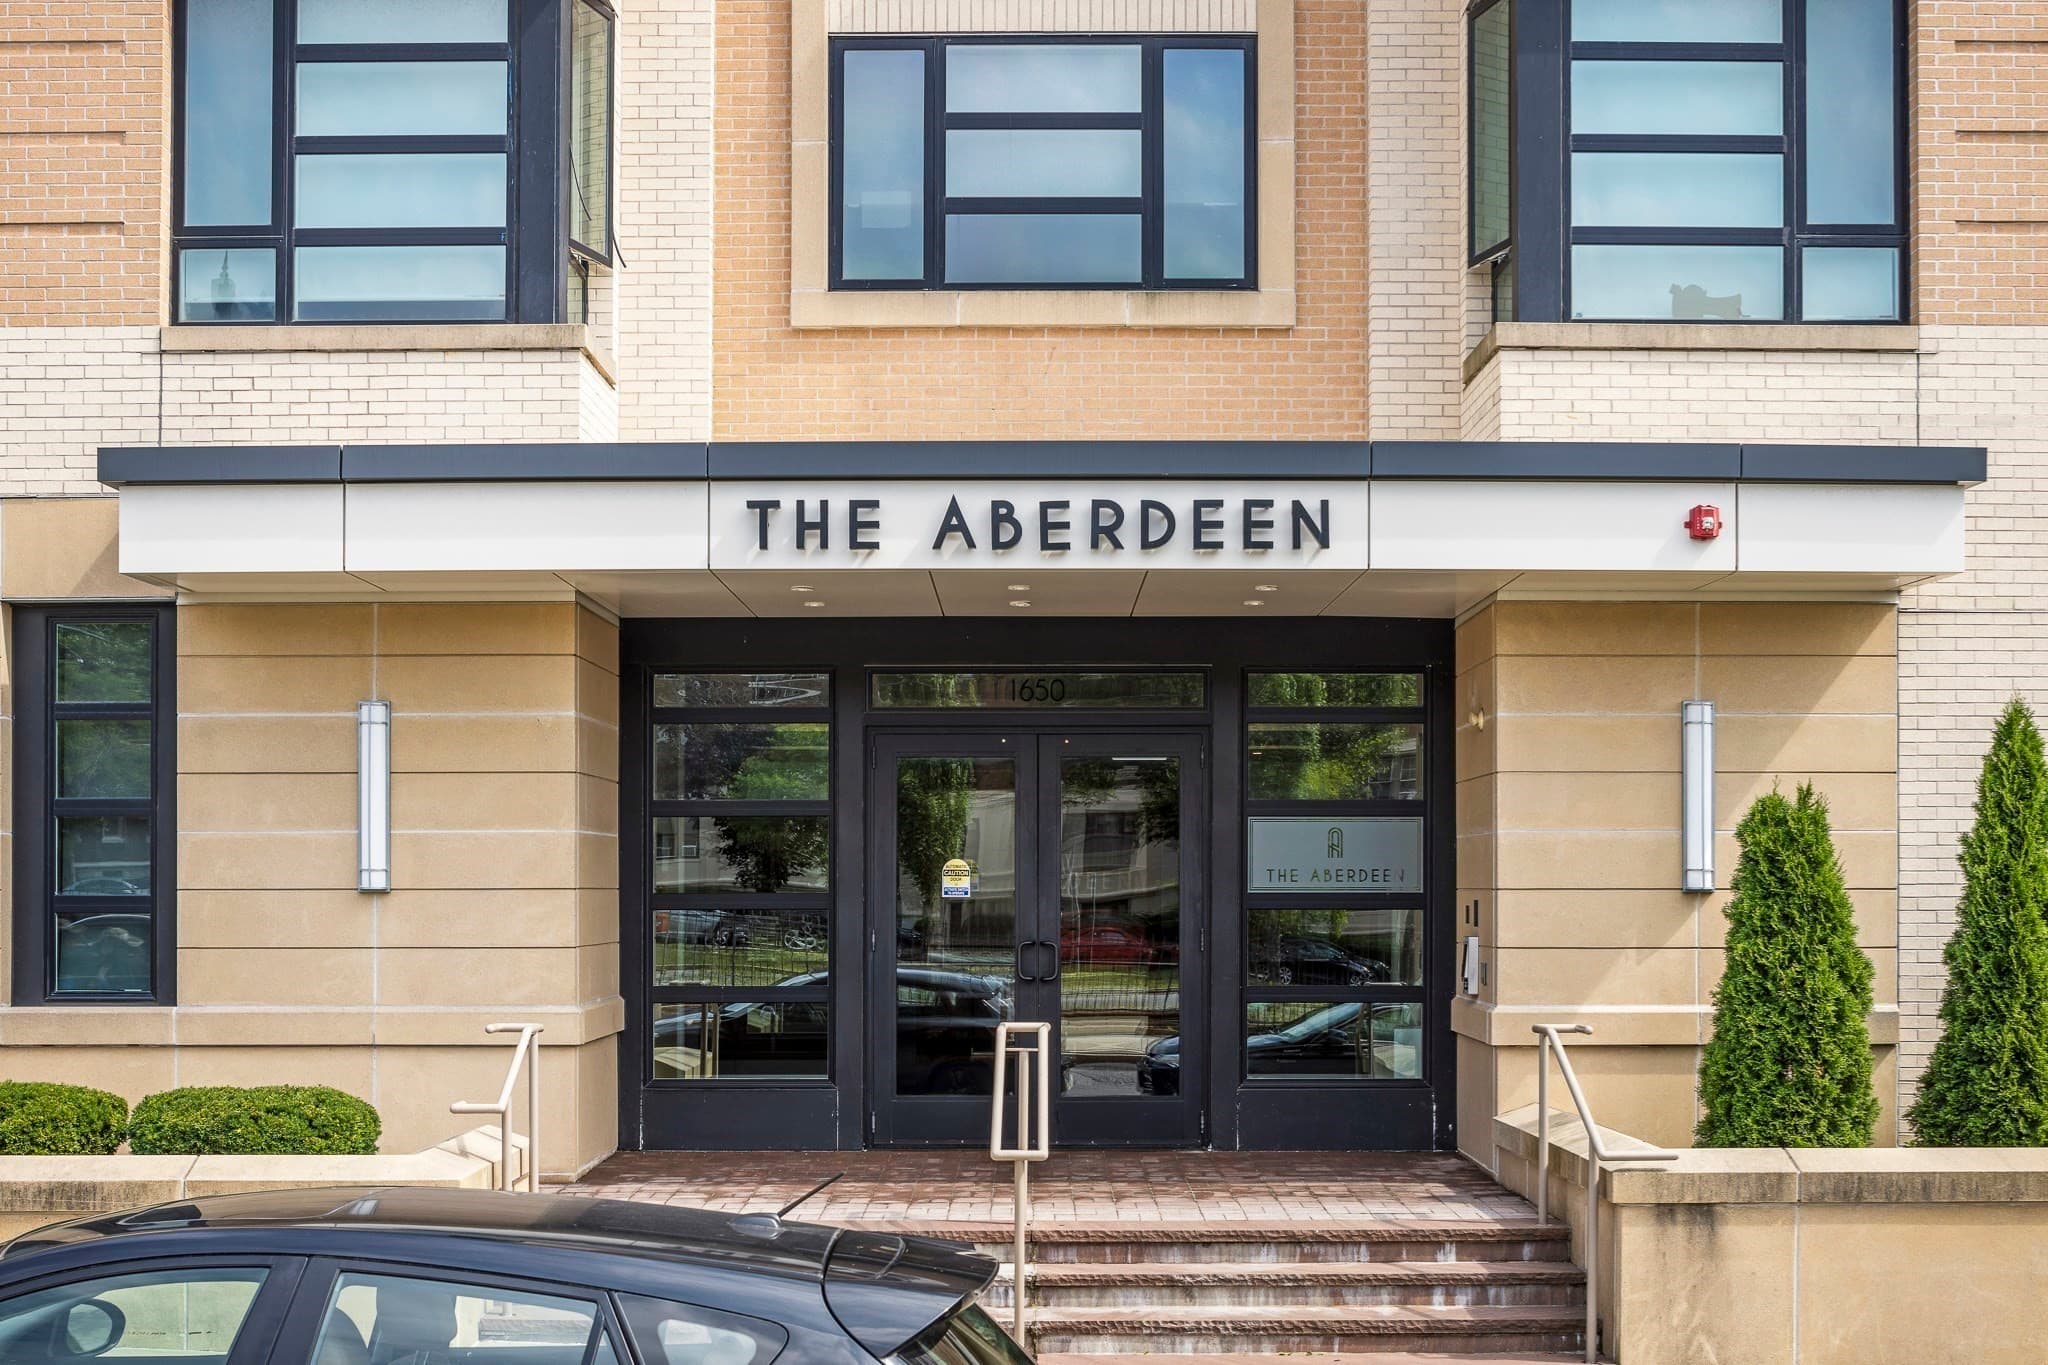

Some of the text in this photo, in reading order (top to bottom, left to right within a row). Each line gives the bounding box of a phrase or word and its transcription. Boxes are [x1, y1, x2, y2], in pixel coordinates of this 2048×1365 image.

[747, 495, 1330, 550] THE ABERDEEN
[1011, 679, 1065, 701] 1650
[1266, 868, 1299, 882] THE
